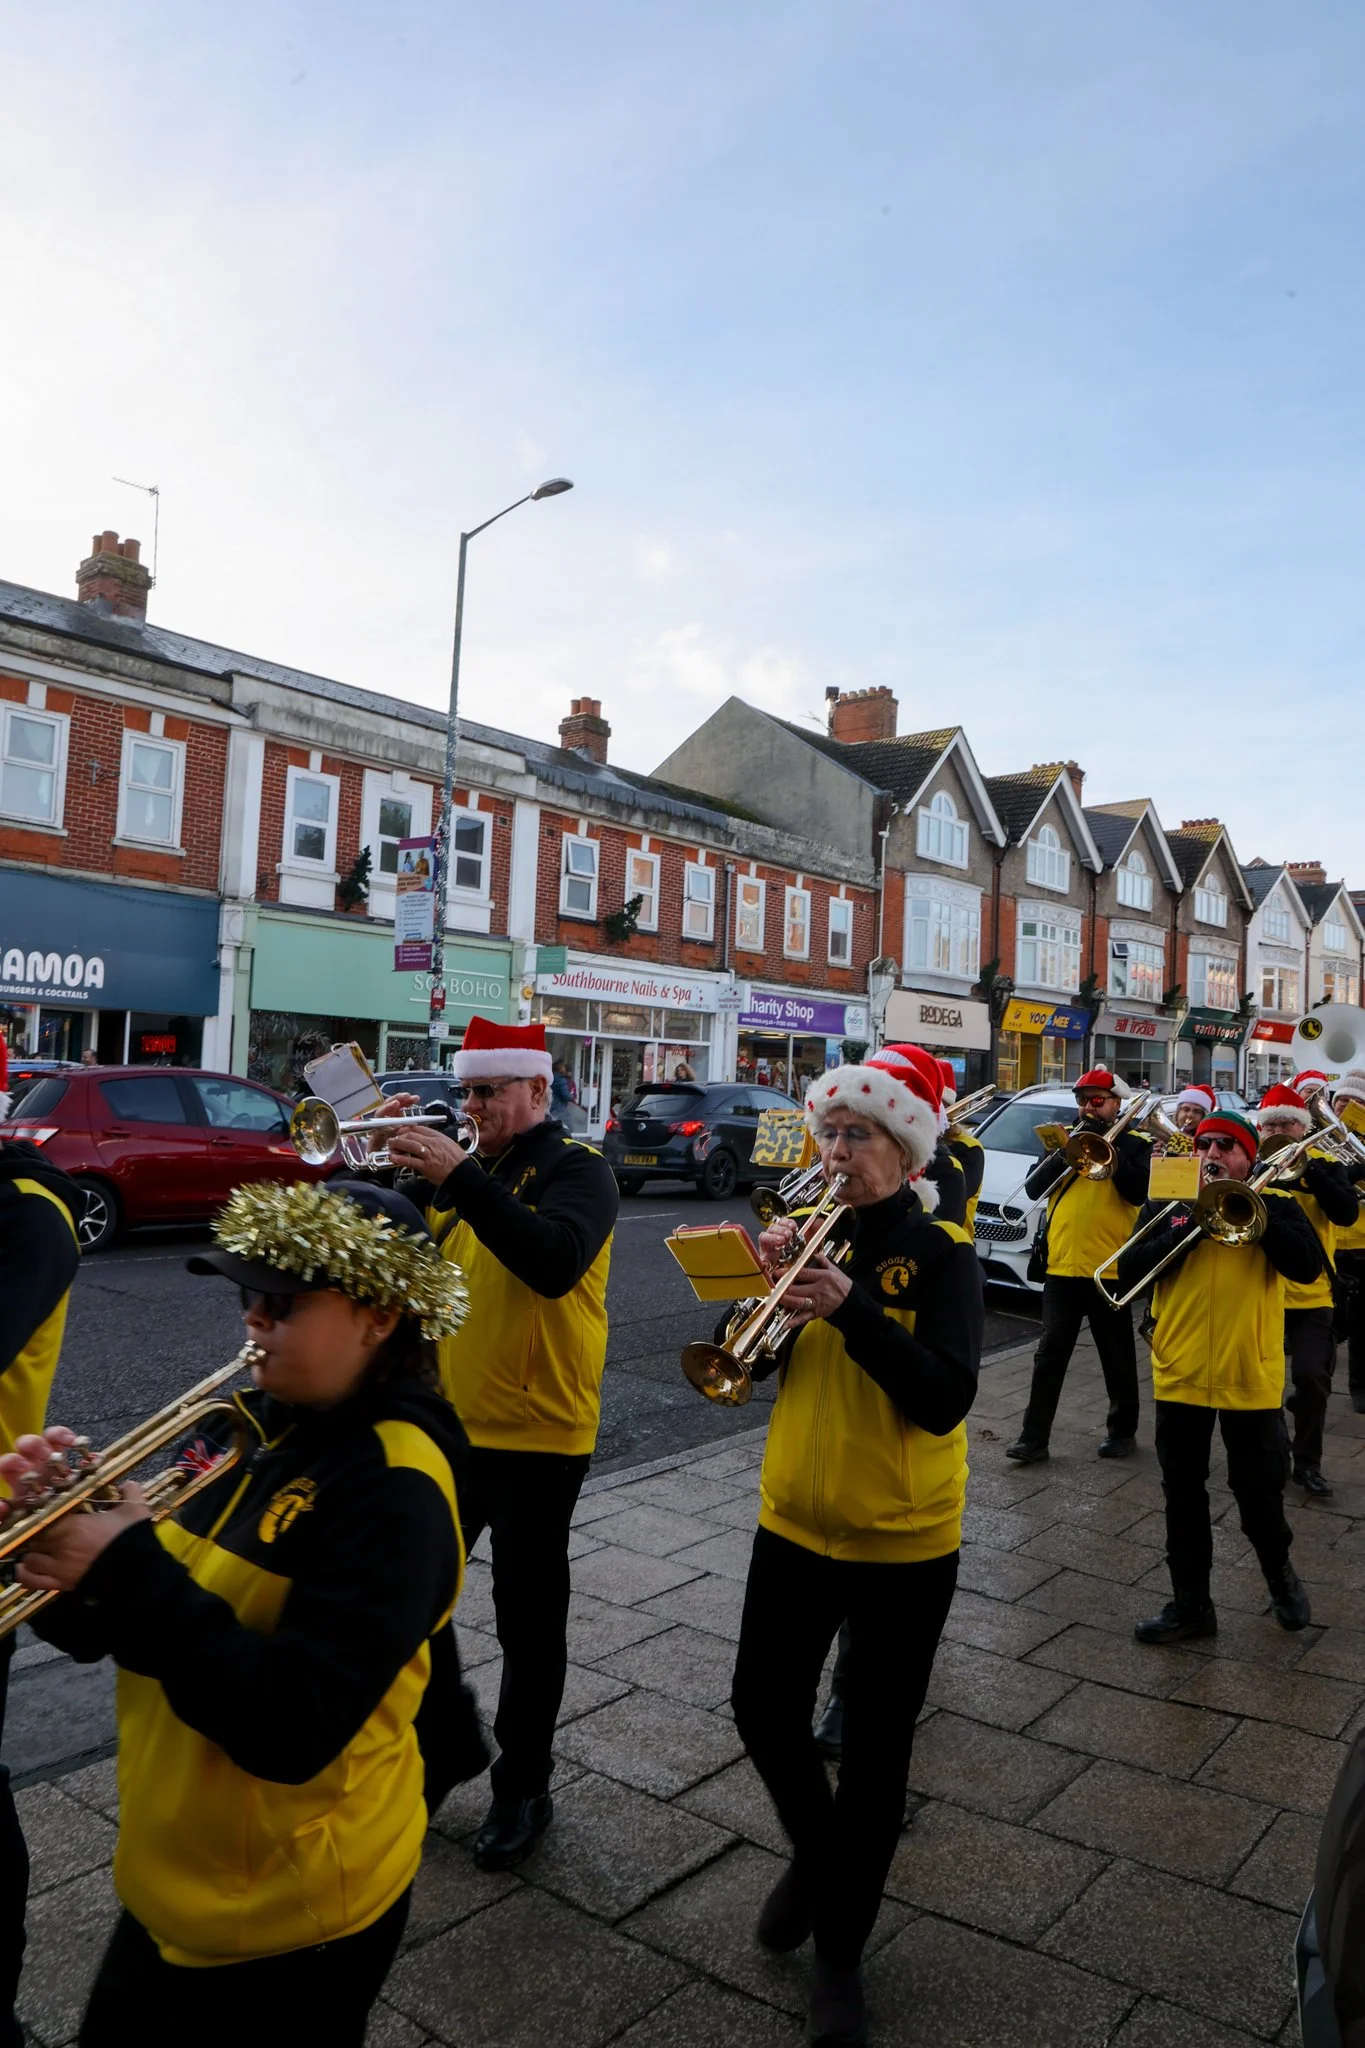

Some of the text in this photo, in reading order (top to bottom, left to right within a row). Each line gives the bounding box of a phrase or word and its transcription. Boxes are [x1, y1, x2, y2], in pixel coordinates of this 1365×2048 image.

[0, 947, 105, 989] AMOA
[37, 988, 43, 996] &
[45, 988, 88, 999] COCKTAILS
[450, 978, 502, 999] BOHO
[552, 971, 692, 1005] Southbourne Nails & Spa
[751, 996, 814, 1022] harity Shop
[920, 1004, 963, 1028] BODEGA
[1029, 1012, 1047, 1025] YOO
[1052, 1015, 1071, 1029] MEE
[1194, 1023, 1215, 1036] earth
[1216, 1025, 1240, 1039] foods
[875, 1256, 905, 1272] GUGGE
